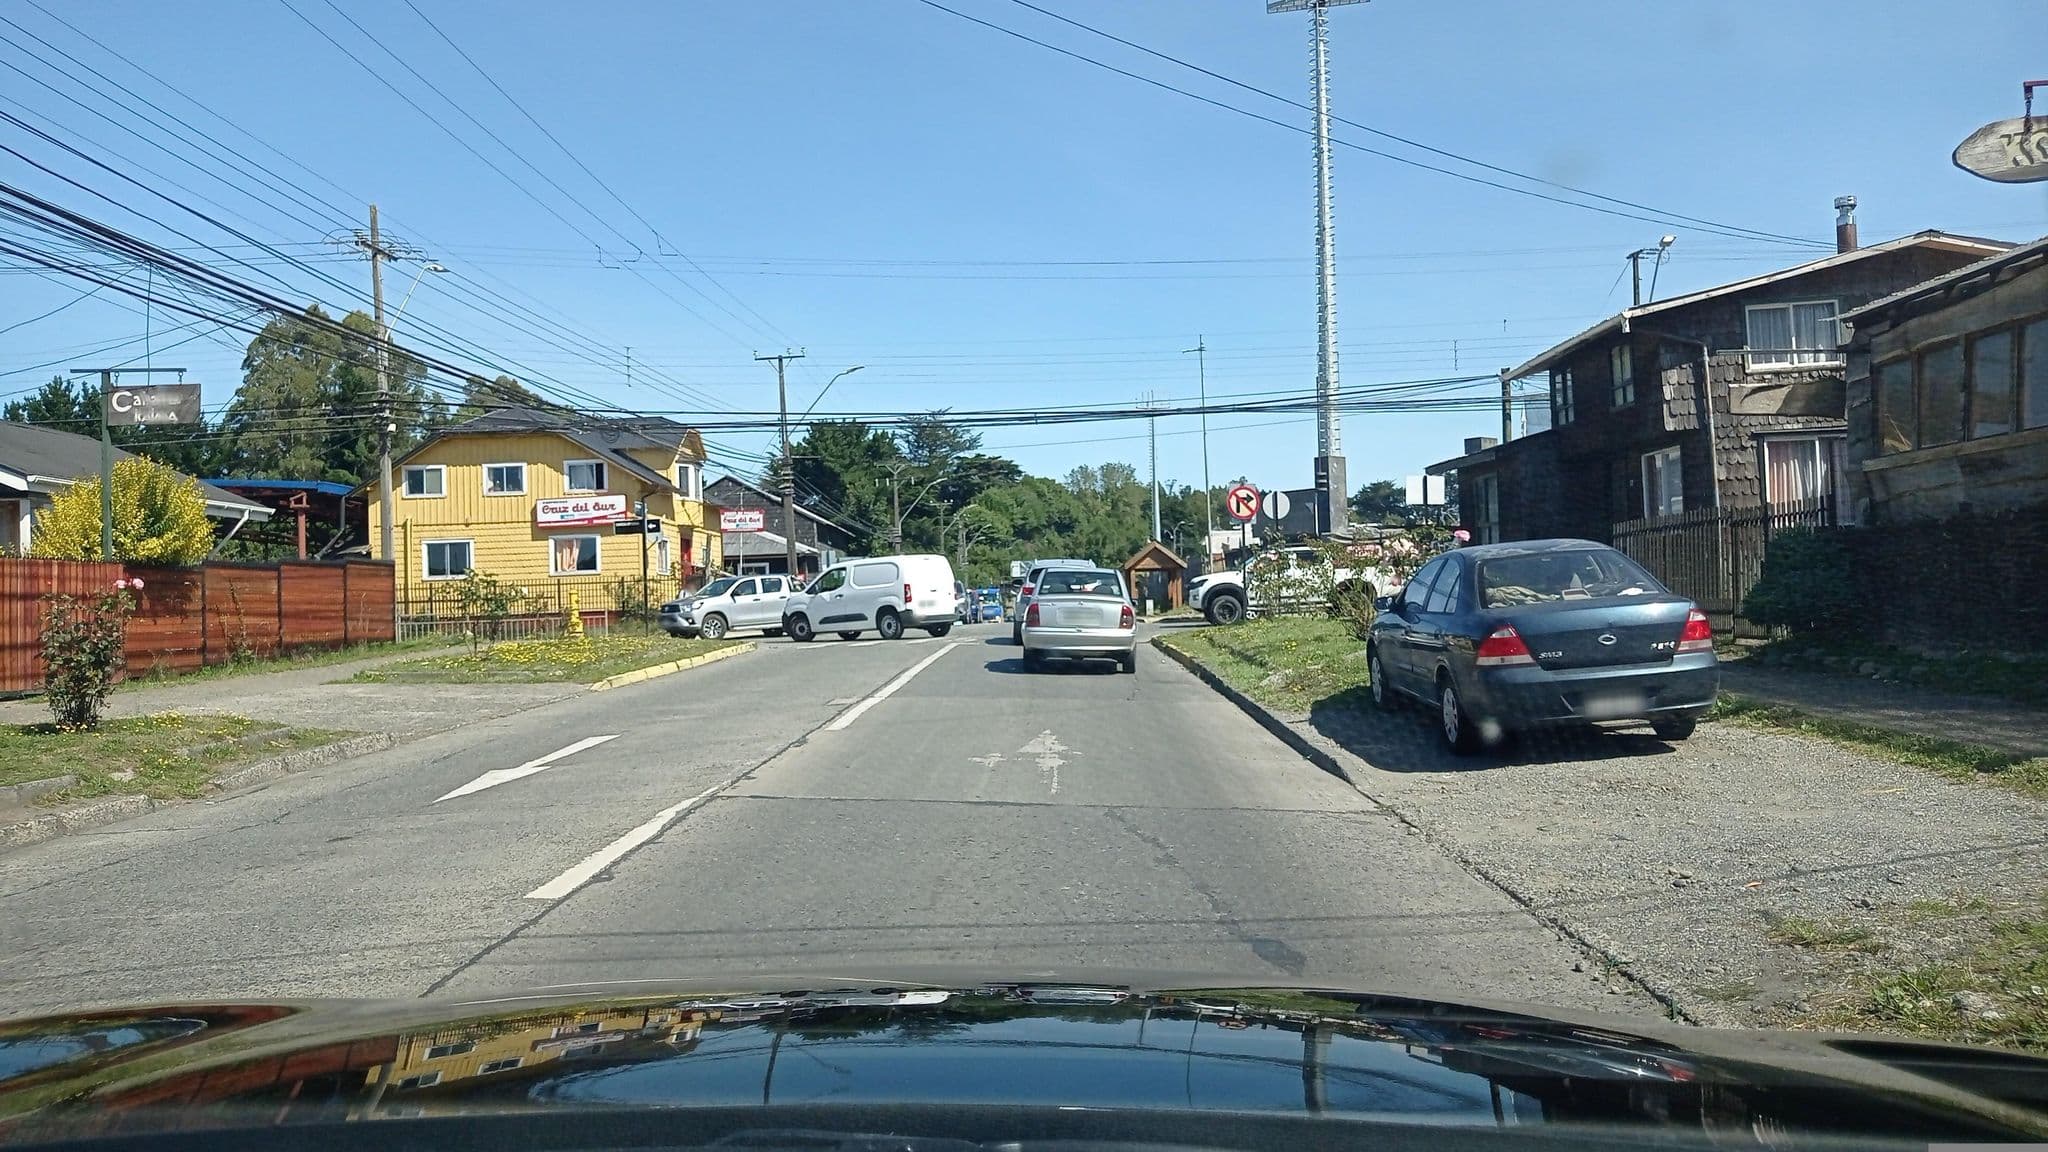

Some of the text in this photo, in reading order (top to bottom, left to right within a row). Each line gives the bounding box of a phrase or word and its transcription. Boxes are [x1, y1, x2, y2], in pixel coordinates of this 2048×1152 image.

[542, 502, 617, 514] Cruz del Sur
